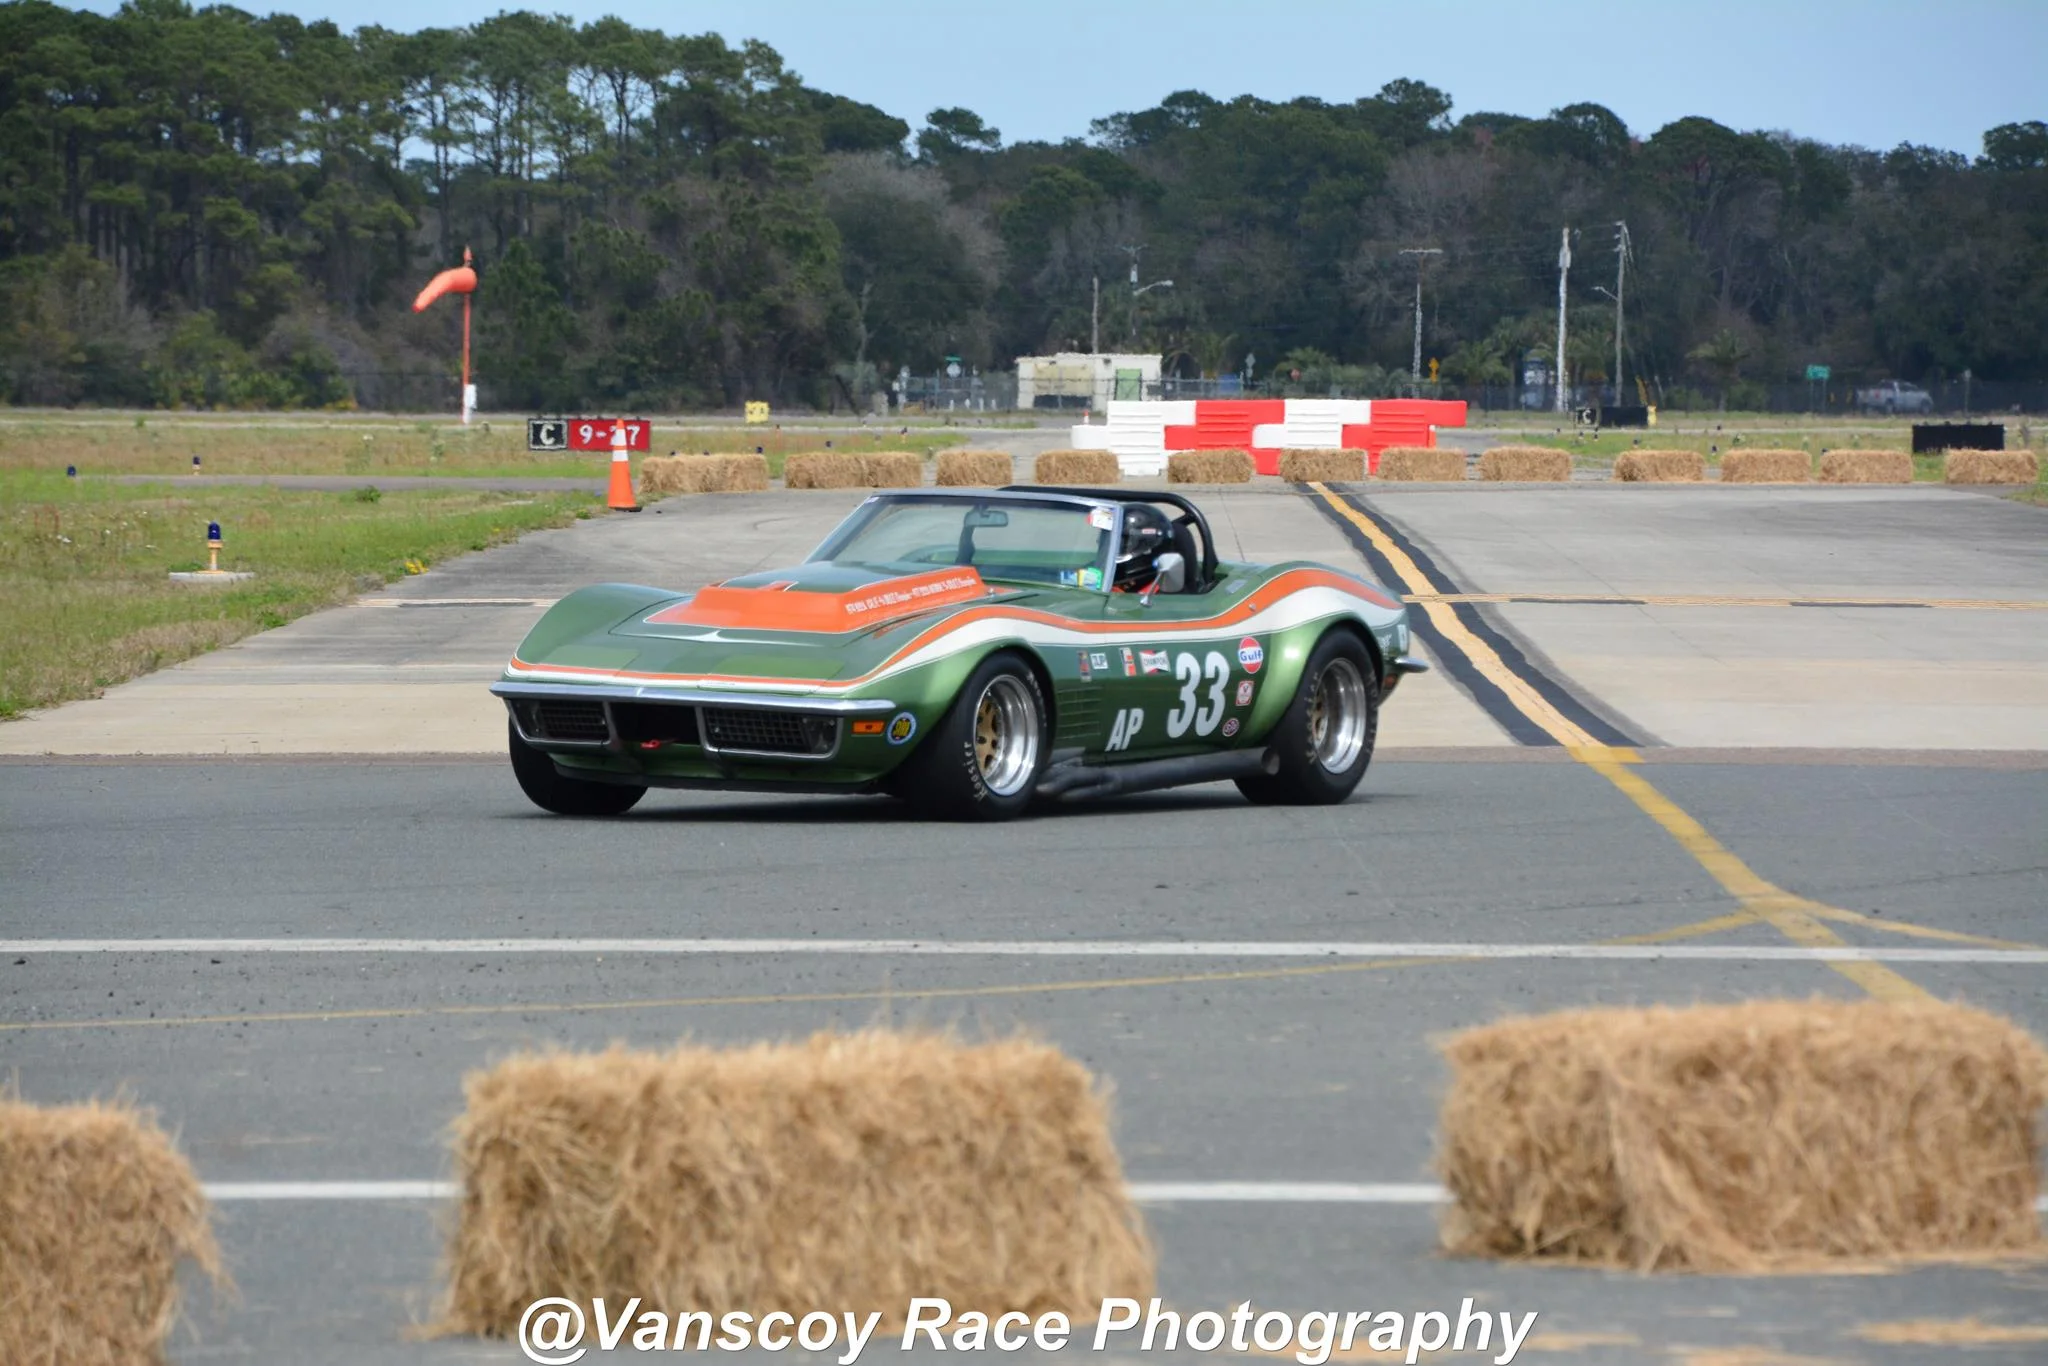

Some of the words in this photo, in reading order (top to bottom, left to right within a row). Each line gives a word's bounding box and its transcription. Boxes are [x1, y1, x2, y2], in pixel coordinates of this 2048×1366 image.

[540, 424, 555, 446] C
[1240, 650, 1262, 662] Gulf
[1166, 651, 1231, 739] 33
[1105, 708, 1145, 752] AP
